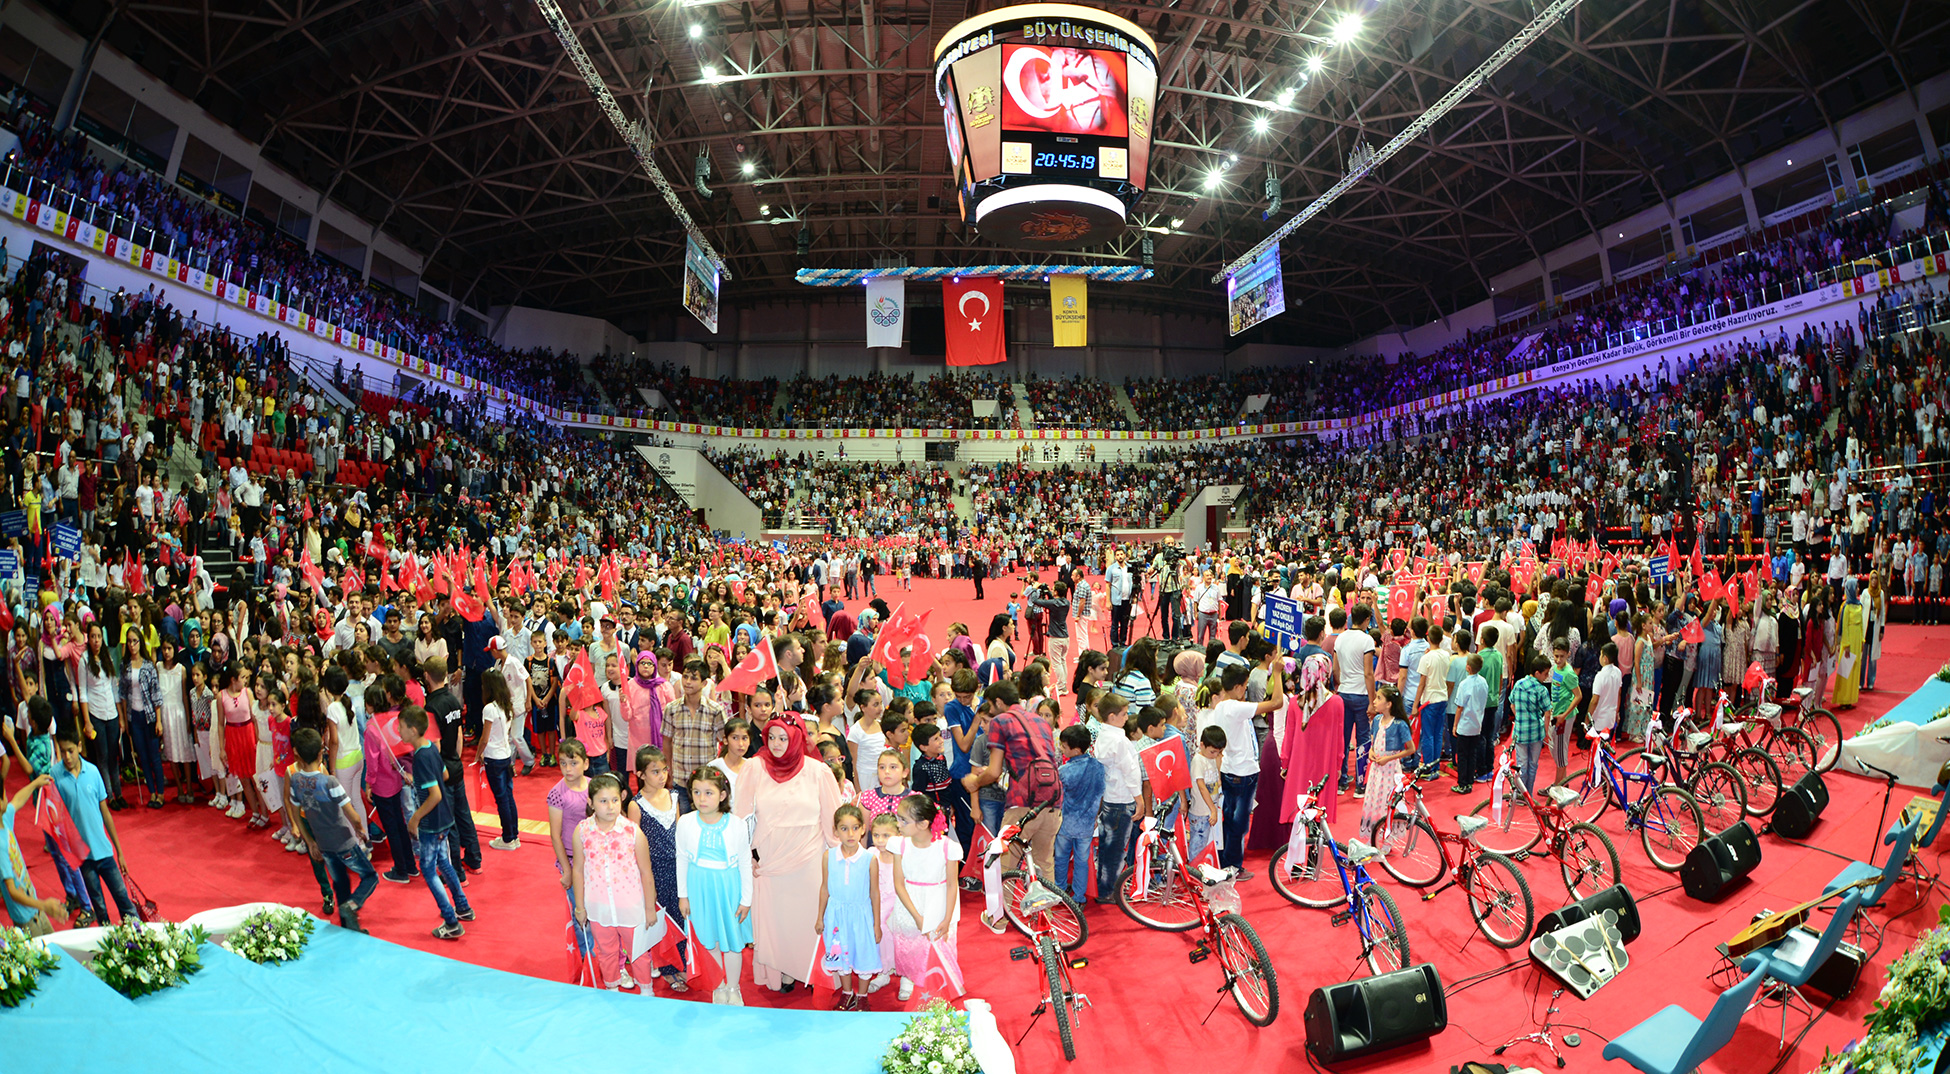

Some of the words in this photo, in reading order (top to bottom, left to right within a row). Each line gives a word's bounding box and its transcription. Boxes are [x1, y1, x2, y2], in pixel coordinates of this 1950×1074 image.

[1023, 21, 1129, 52] BÜYÜKŞEHİR
[1034, 152, 1096, 170] 20:45:19
[1551, 361, 1577, 373] Konya'yı
[1577, 353, 1602, 367] Geçmişi
[1602, 349, 1622, 360] Kadar
[1623, 343, 1646, 355] Büyük,
[1646, 332, 1679, 348] Görkemli
[1680, 329, 1691, 340] Bir
[1692, 320, 1726, 336] Geleceğe
[1727, 307, 1778, 326] Hazırlıyoruz.
[1271, 609, 1280, 618] YAZ
[1280, 611, 1295, 623] OKULU
